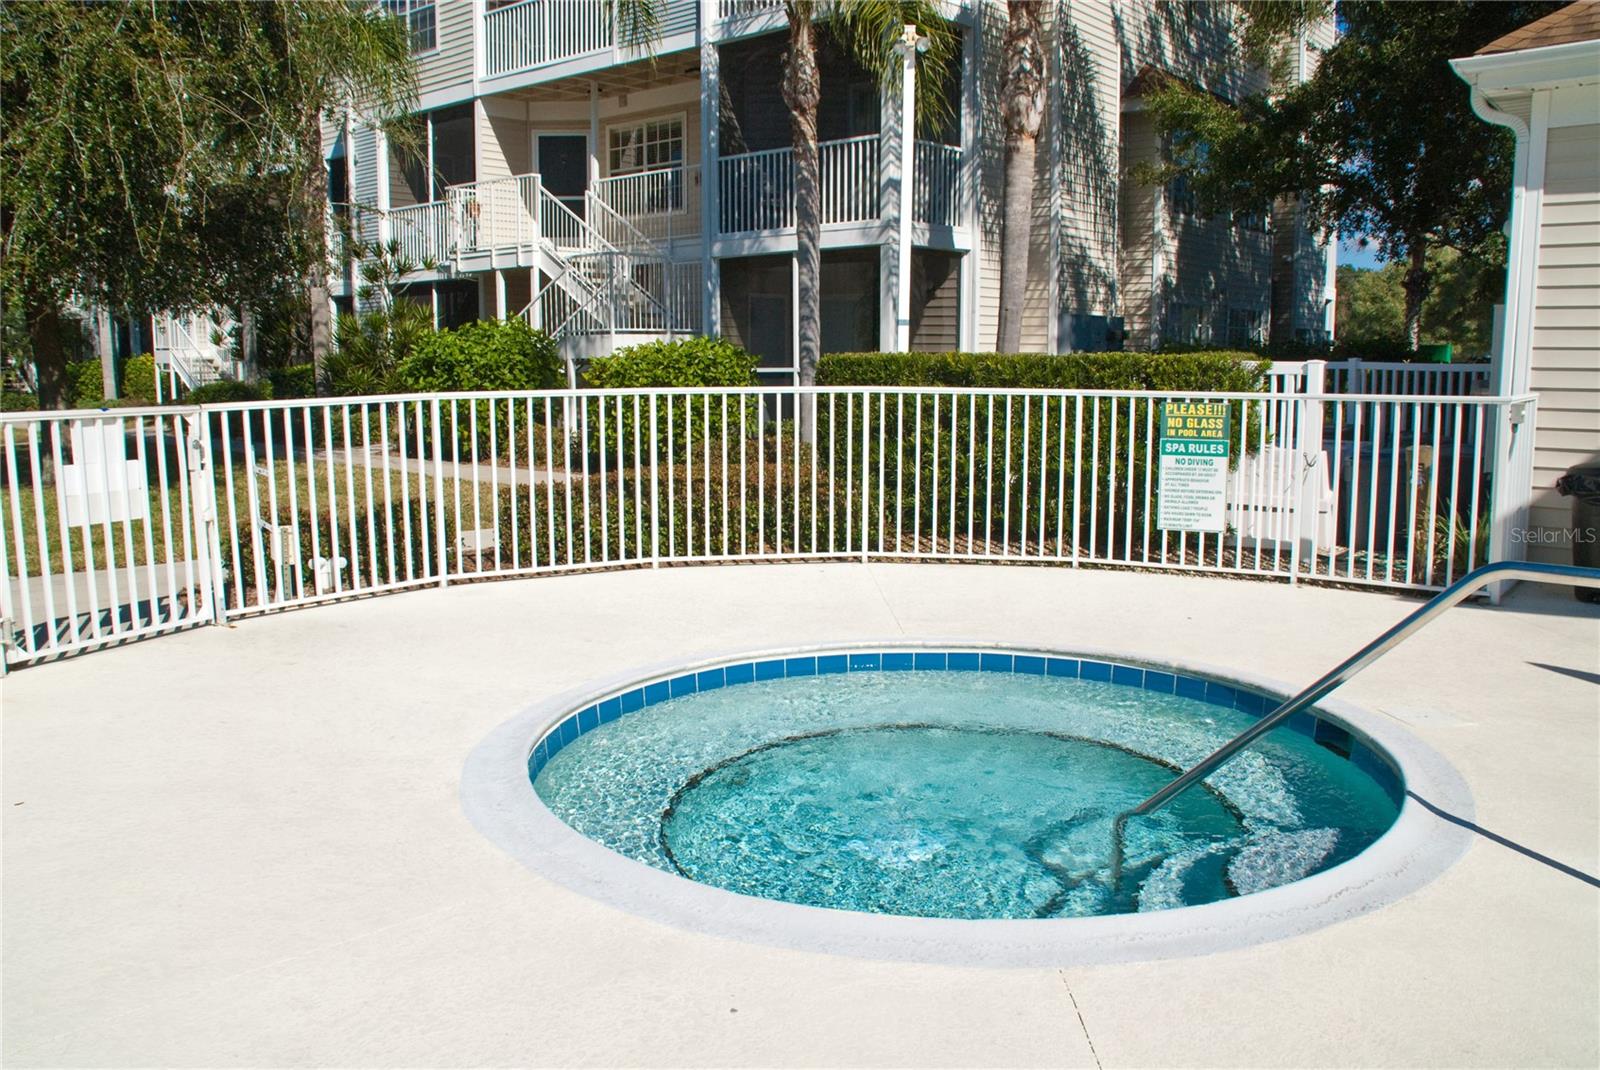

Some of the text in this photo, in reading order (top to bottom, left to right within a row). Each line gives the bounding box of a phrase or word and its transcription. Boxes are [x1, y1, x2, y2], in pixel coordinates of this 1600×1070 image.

[1166, 403, 1226, 416] PLEASE!!!
[1167, 418, 1224, 429] NO GLASS
[1200, 430, 1223, 438] AREA
[1165, 443, 1224, 454] SPA RULES
